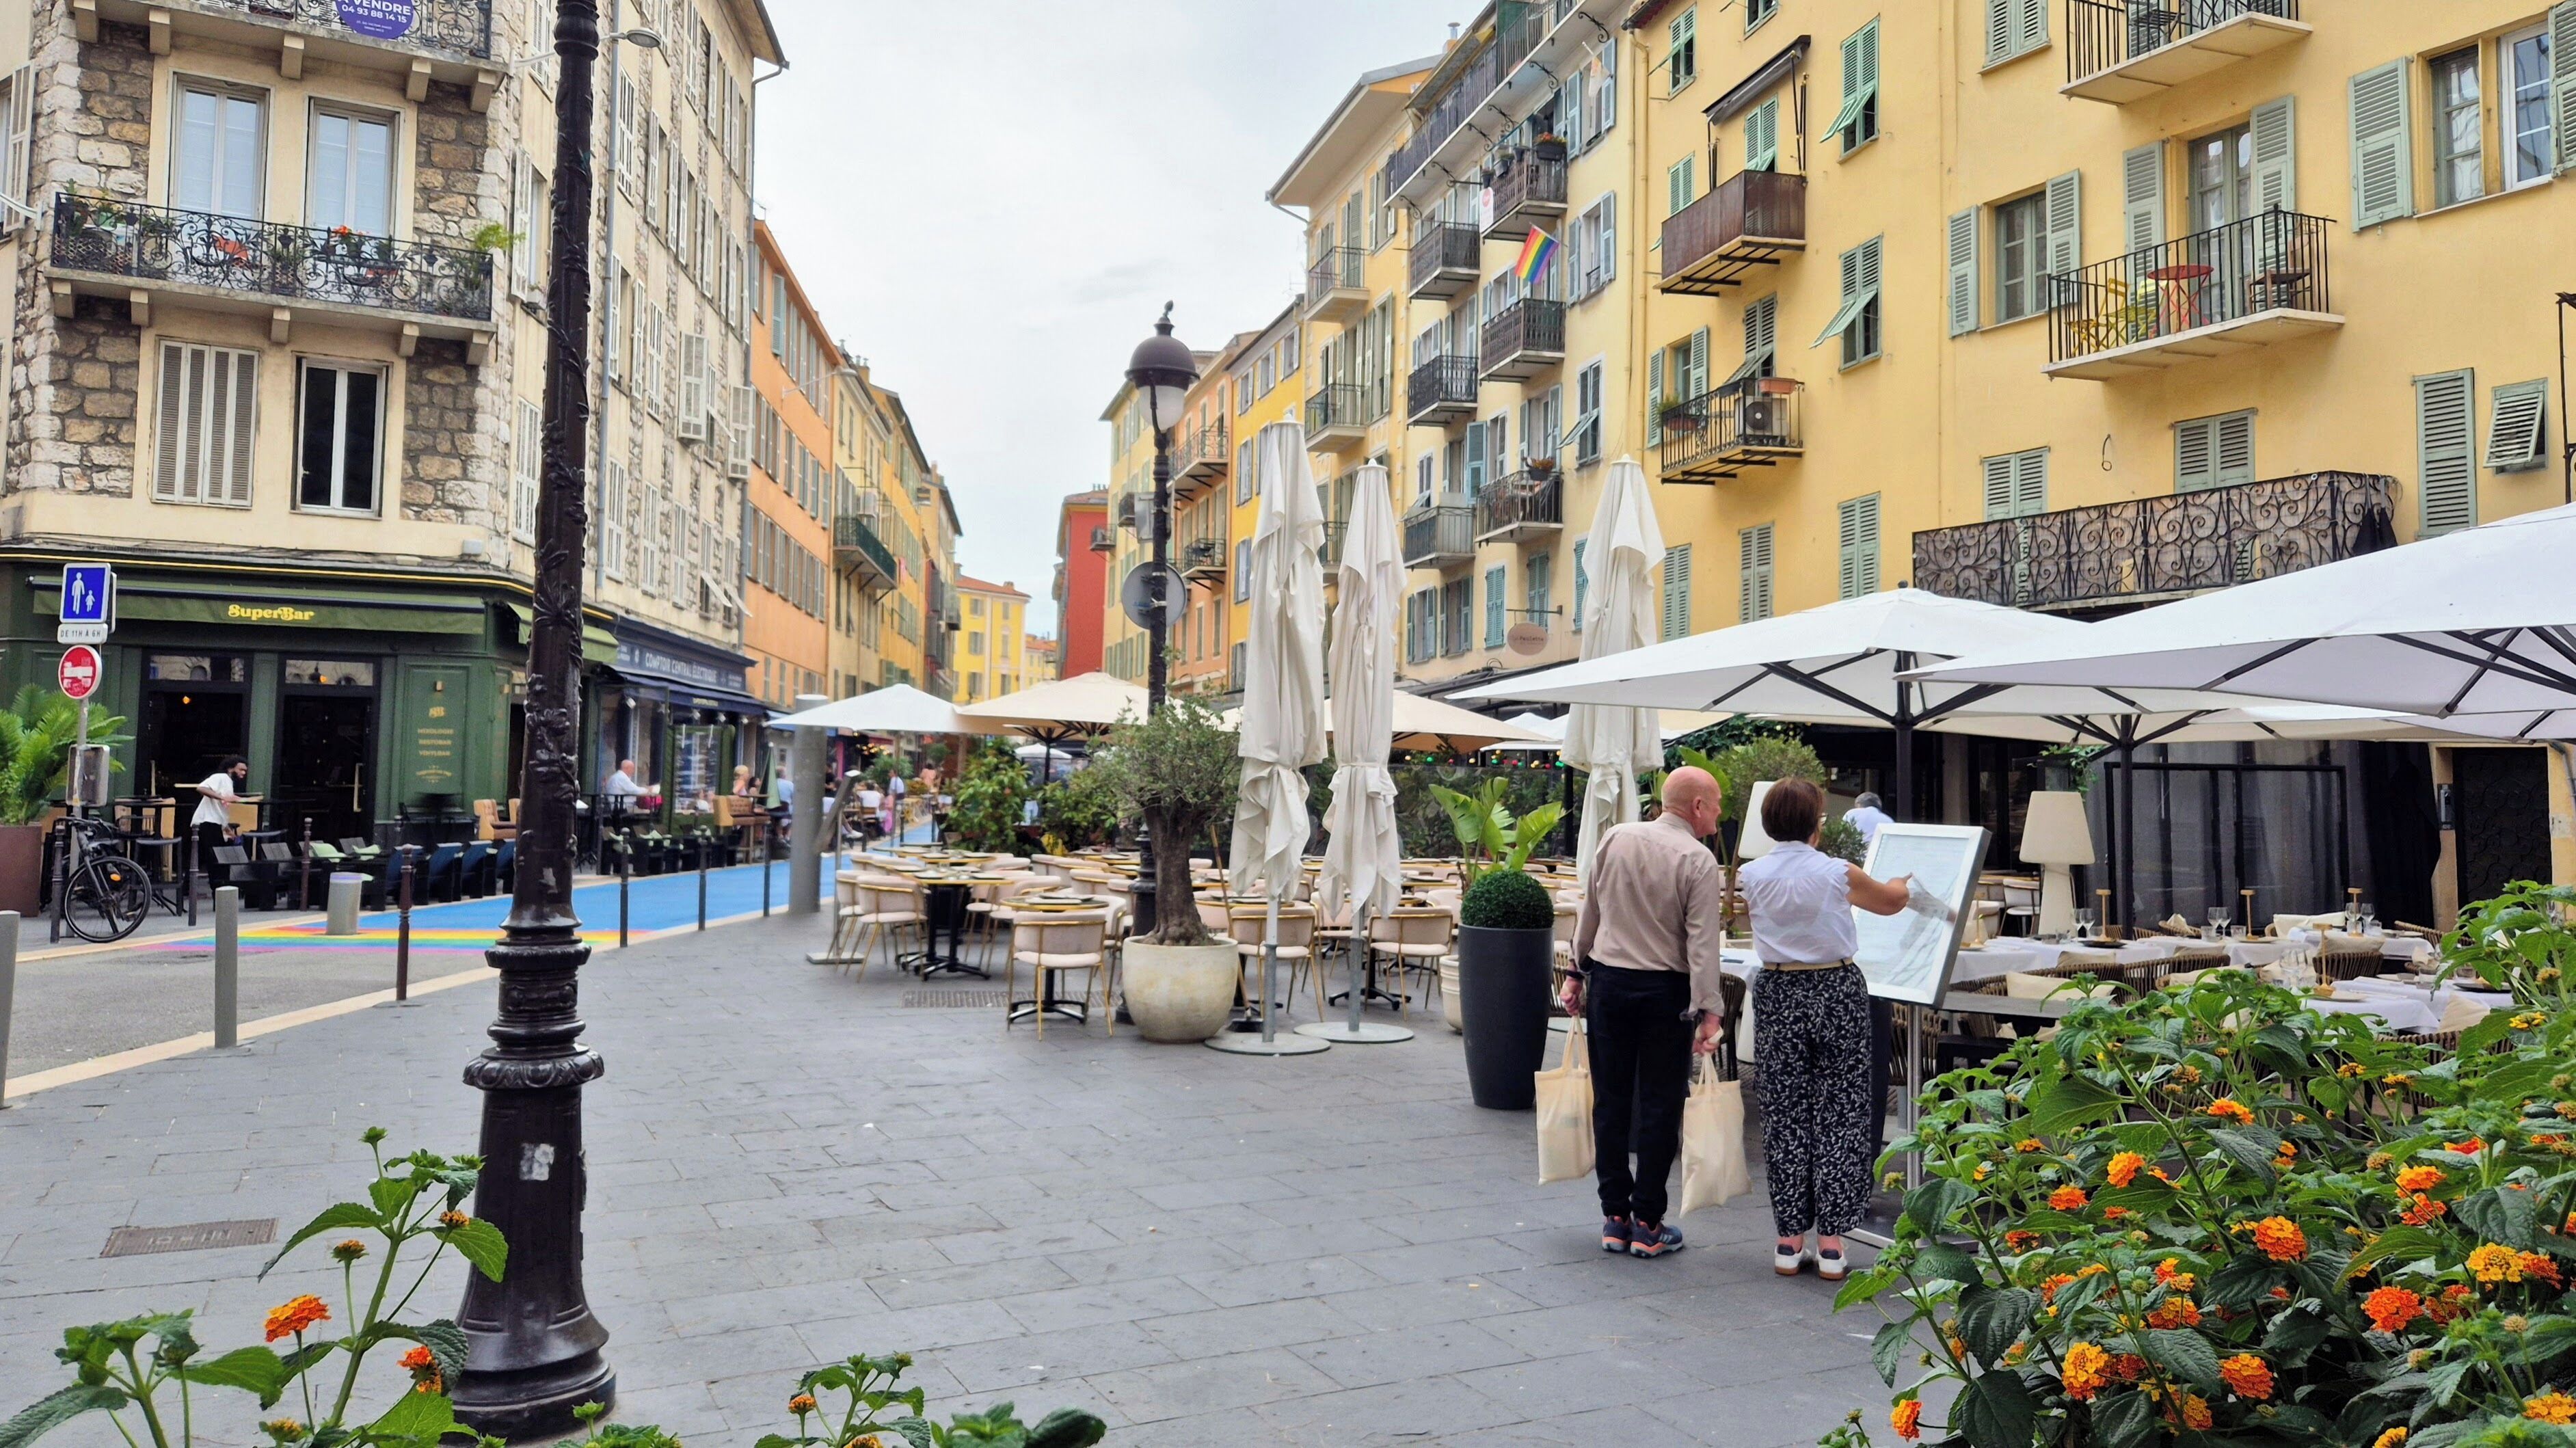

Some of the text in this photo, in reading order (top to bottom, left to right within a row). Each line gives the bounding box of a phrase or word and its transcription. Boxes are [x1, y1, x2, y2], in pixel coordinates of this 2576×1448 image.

[342, 4, 407, 23] 04 93 88 14 15
[353, 0, 412, 15] VENDRE
[228, 604, 315, 621] SuperBar
[92, 629, 101, 637] 6H
[645, 653, 671, 673] COMPTOIR
[671, 660, 693, 677] CENTRAL
